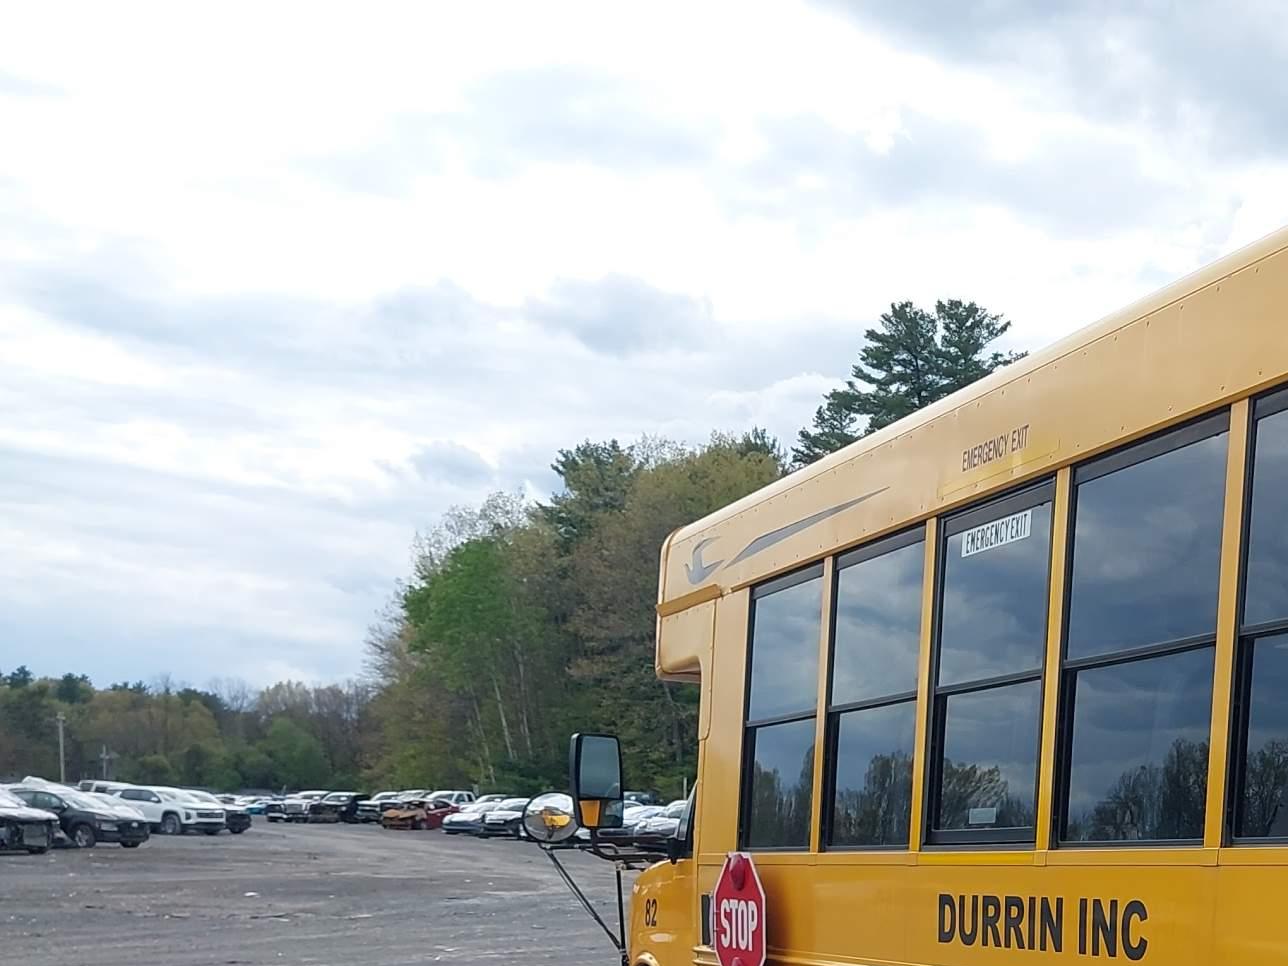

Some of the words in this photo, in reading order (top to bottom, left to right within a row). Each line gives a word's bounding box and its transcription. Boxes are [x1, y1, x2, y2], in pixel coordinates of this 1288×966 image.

[962, 433, 1009, 473] EMERGENCY
[1010, 424, 1030, 453] EXIT
[966, 520, 1010, 554] EMERGENCY
[1010, 513, 1028, 540] EXIT
[645, 898, 658, 927] 82
[720, 898, 758, 952] STOP
[937, 893, 1064, 953] DURRIN
[1078, 897, 1148, 961] INC
